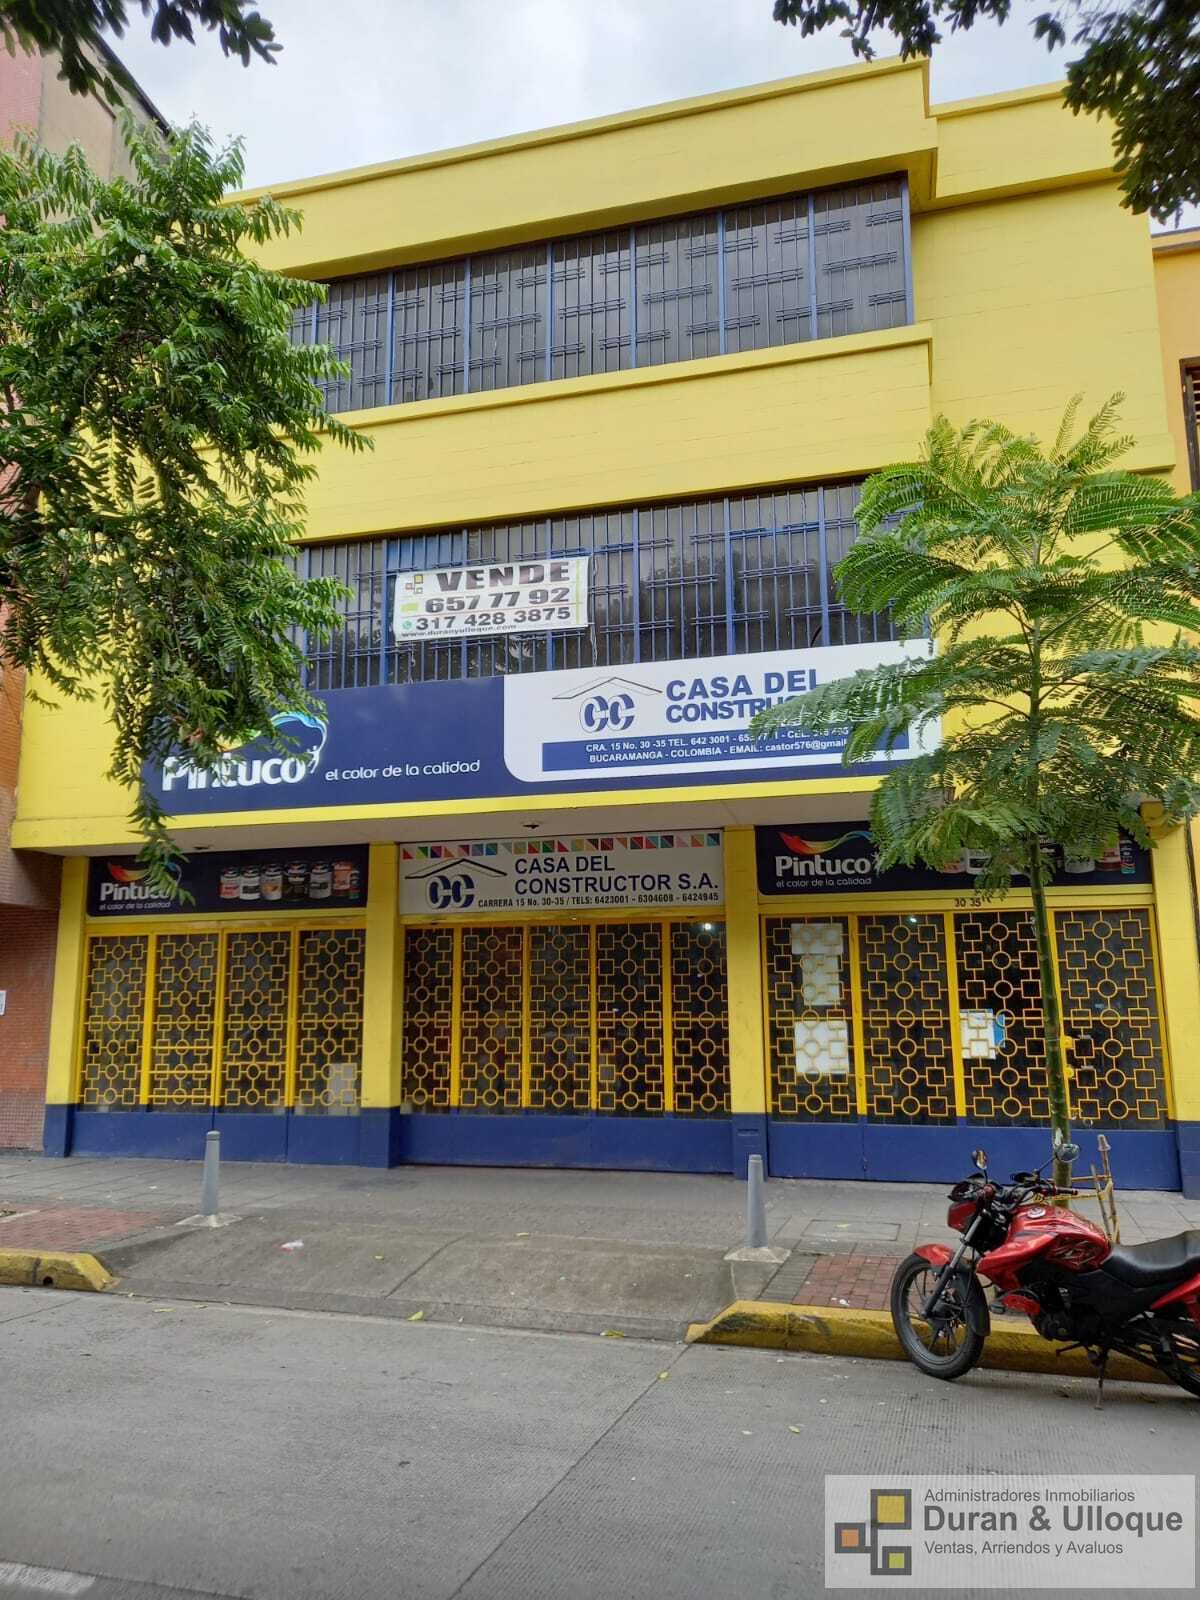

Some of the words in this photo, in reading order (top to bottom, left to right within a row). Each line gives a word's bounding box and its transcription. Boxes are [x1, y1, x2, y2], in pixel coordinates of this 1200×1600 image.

[436, 562, 570, 592] VENDE
[425, 595, 480, 613] 657
[488, 591, 520, 608] 77
[529, 587, 570, 604] 92
[416, 616, 456, 630] 317
[464, 612, 506, 627] 428
[513, 607, 571, 623] 3875
[666, 674, 753, 701] CASA
[666, 695, 800, 723] CONSTRU
[611, 742, 621, 750] 15
[622, 742, 638, 750] No.
[640, 741, 650, 749] 30
[668, 738, 688, 747] TEL.
[691, 737, 706, 745] 642
[709, 735, 730, 744] 3001
[589, 750, 663, 763] BUCARAMANGA
[670, 747, 721, 758] COLOMBIA
[325, 769, 339, 781] el
[342, 767, 379, 780] color
[382, 765, 402, 778] de
[405, 764, 420, 776] la
[423, 760, 480, 775] calidad
[515, 857, 570, 874] CASA
[576, 855, 615, 872] DEL
[775, 855, 871, 877] Pintuco
[515, 874, 672, 895] CONSTRUCTOR
[678, 873, 719, 890] S.A.
[776, 880, 785, 888] el
[786, 879, 809, 888] color
[811, 878, 823, 886] de
[825, 878, 834, 886] la
[836, 877, 872, 886] calidad
[479, 898, 513, 908] CARRERA
[571, 896, 592, 905] TELS:
